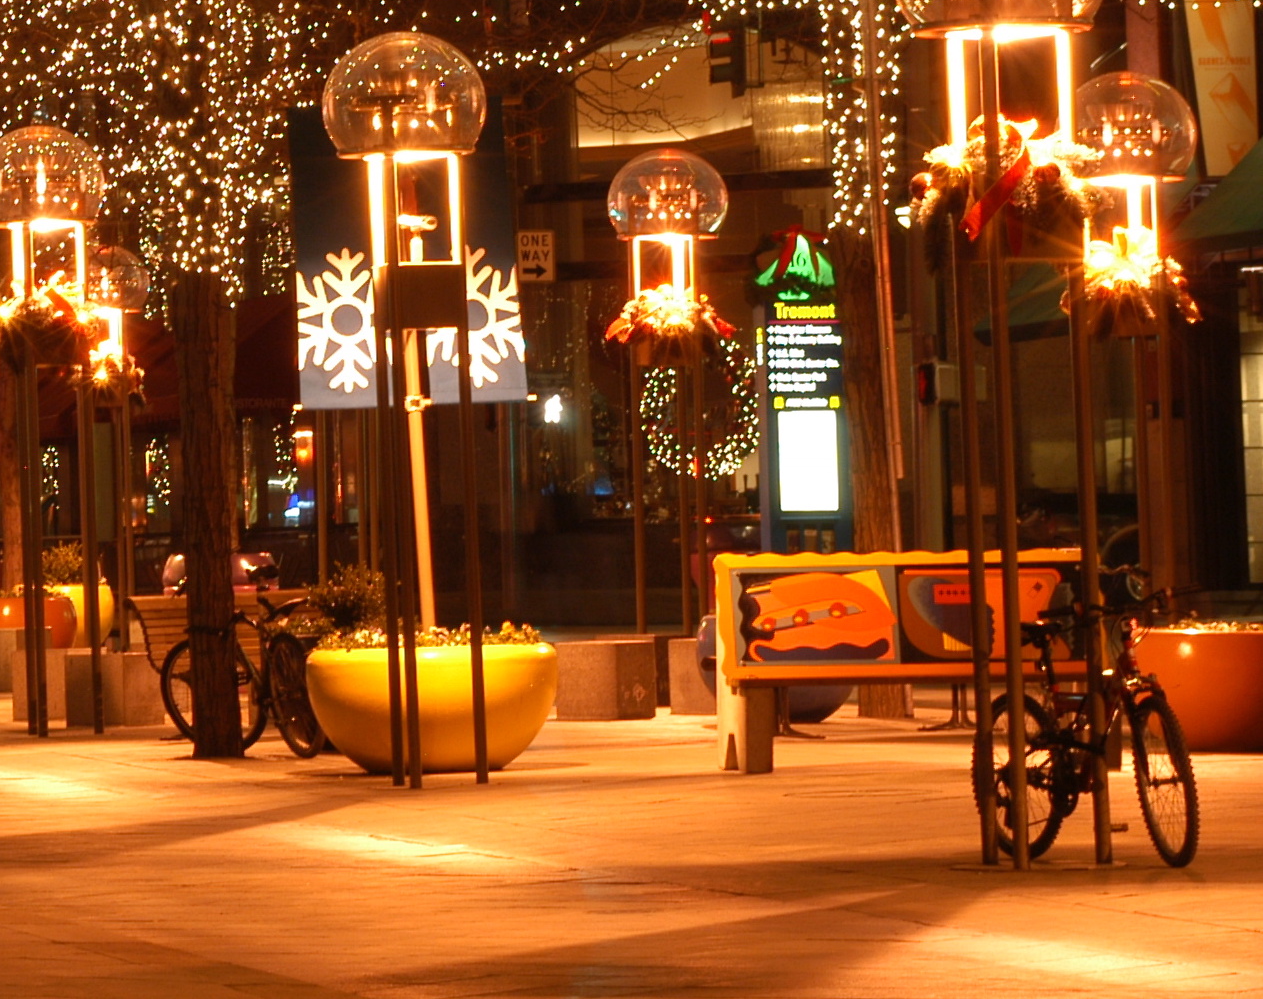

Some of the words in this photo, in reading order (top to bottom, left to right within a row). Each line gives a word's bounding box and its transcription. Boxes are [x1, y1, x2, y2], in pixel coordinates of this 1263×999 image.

[520, 234, 549, 247] ONE
[521, 249, 550, 262] WAY
[773, 301, 836, 319] Tremont
